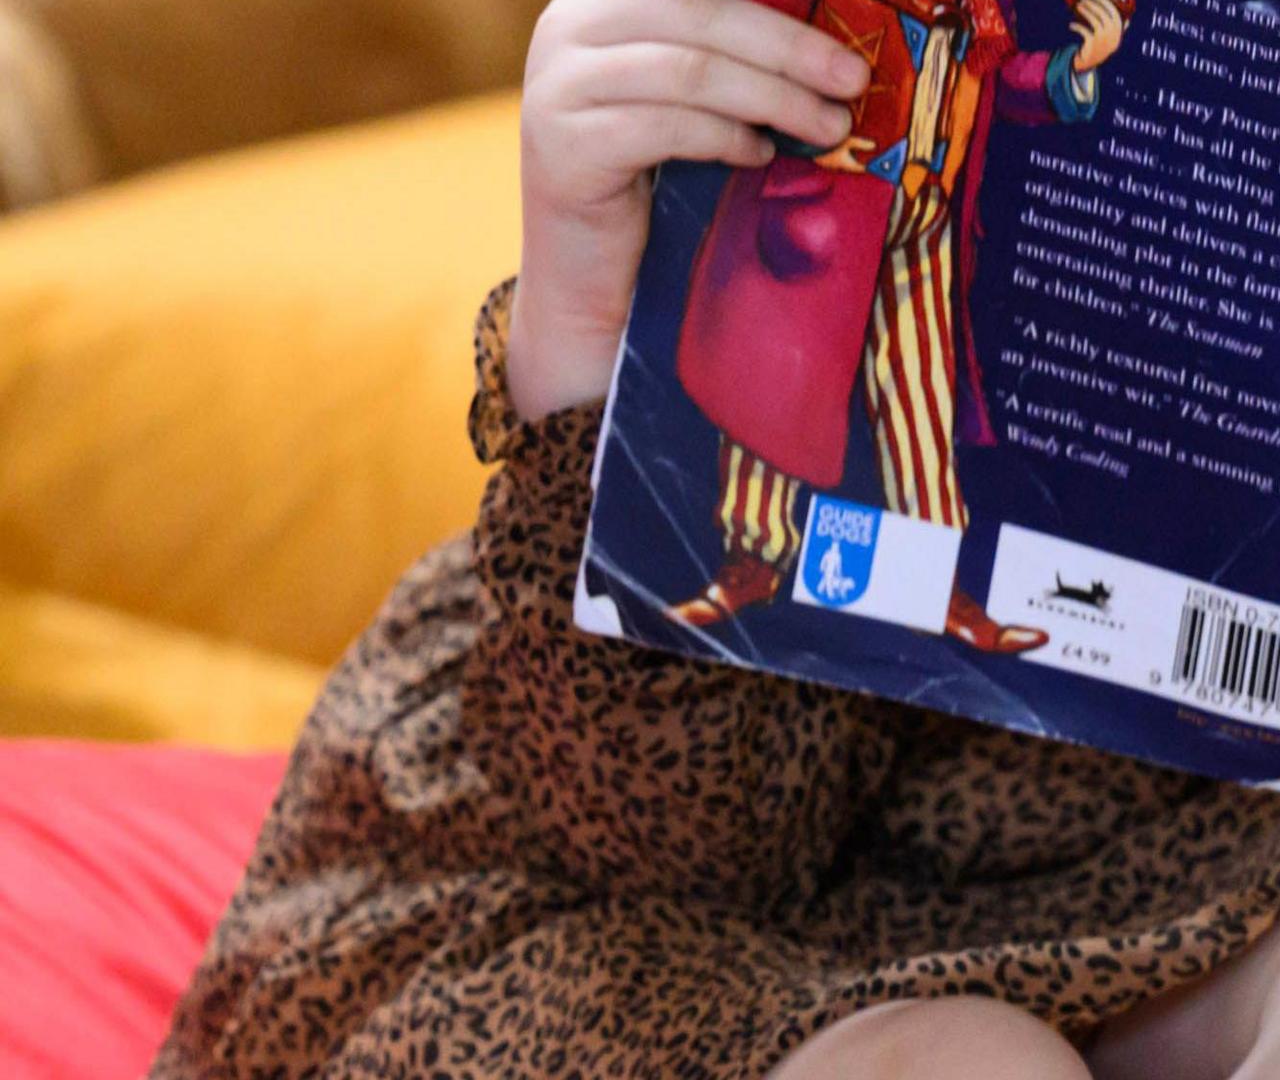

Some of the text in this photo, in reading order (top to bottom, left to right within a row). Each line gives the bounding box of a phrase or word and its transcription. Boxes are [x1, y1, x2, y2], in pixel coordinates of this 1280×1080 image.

[1226, 3, 1236, 17] a
[1142, 38, 1176, 64] this
[1184, 52, 1233, 83] time,
[1113, 107, 1167, 139] Stone
[1174, 124, 1204, 150] has
[1210, 138, 1234, 159] all
[1241, 147, 1271, 170] the
[1158, 88, 1213, 124] Harry
[1221, 106, 1280, 141] Potter
[1030, 150, 1113, 187] narrative
[1119, 174, 1187, 210] devices
[1195, 199, 1239, 225] with
[1192, 162, 1274, 206] Rowling
[1020, 206, 1127, 257] demanding
[1134, 244, 1172, 268] plot
[1181, 255, 1199, 278] in
[1207, 264, 1237, 288] the
[1025, 180, 1124, 226] originality
[1131, 214, 1167, 236] and
[1172, 222, 1246, 259] delivers
[1253, 250, 1263, 265] a
[1013, 266, 1039, 290] for
[1147, 307, 1179, 334] The
[1016, 241, 1132, 290] entertaining
[1217, 298, 1252, 324] She
[1259, 311, 1273, 331] is
[1001, 349, 1024, 367] an
[1030, 354, 1118, 395] inventive
[1179, 399, 1211, 425] The
[1046, 329, 1099, 361] richly
[1107, 349, 1186, 386] textured
[1192, 373, 1230, 400] first
[1027, 402, 1084, 431] terrific
[1094, 423, 1132, 446] read
[1137, 438, 1171, 458] and
[1176, 451, 1186, 463] a
[1192, 454, 1273, 493] stunning
[816, 519, 872, 547] DOGS
[818, 503, 875, 526] GUIDE
[1184, 584, 1239, 617] ISBN
